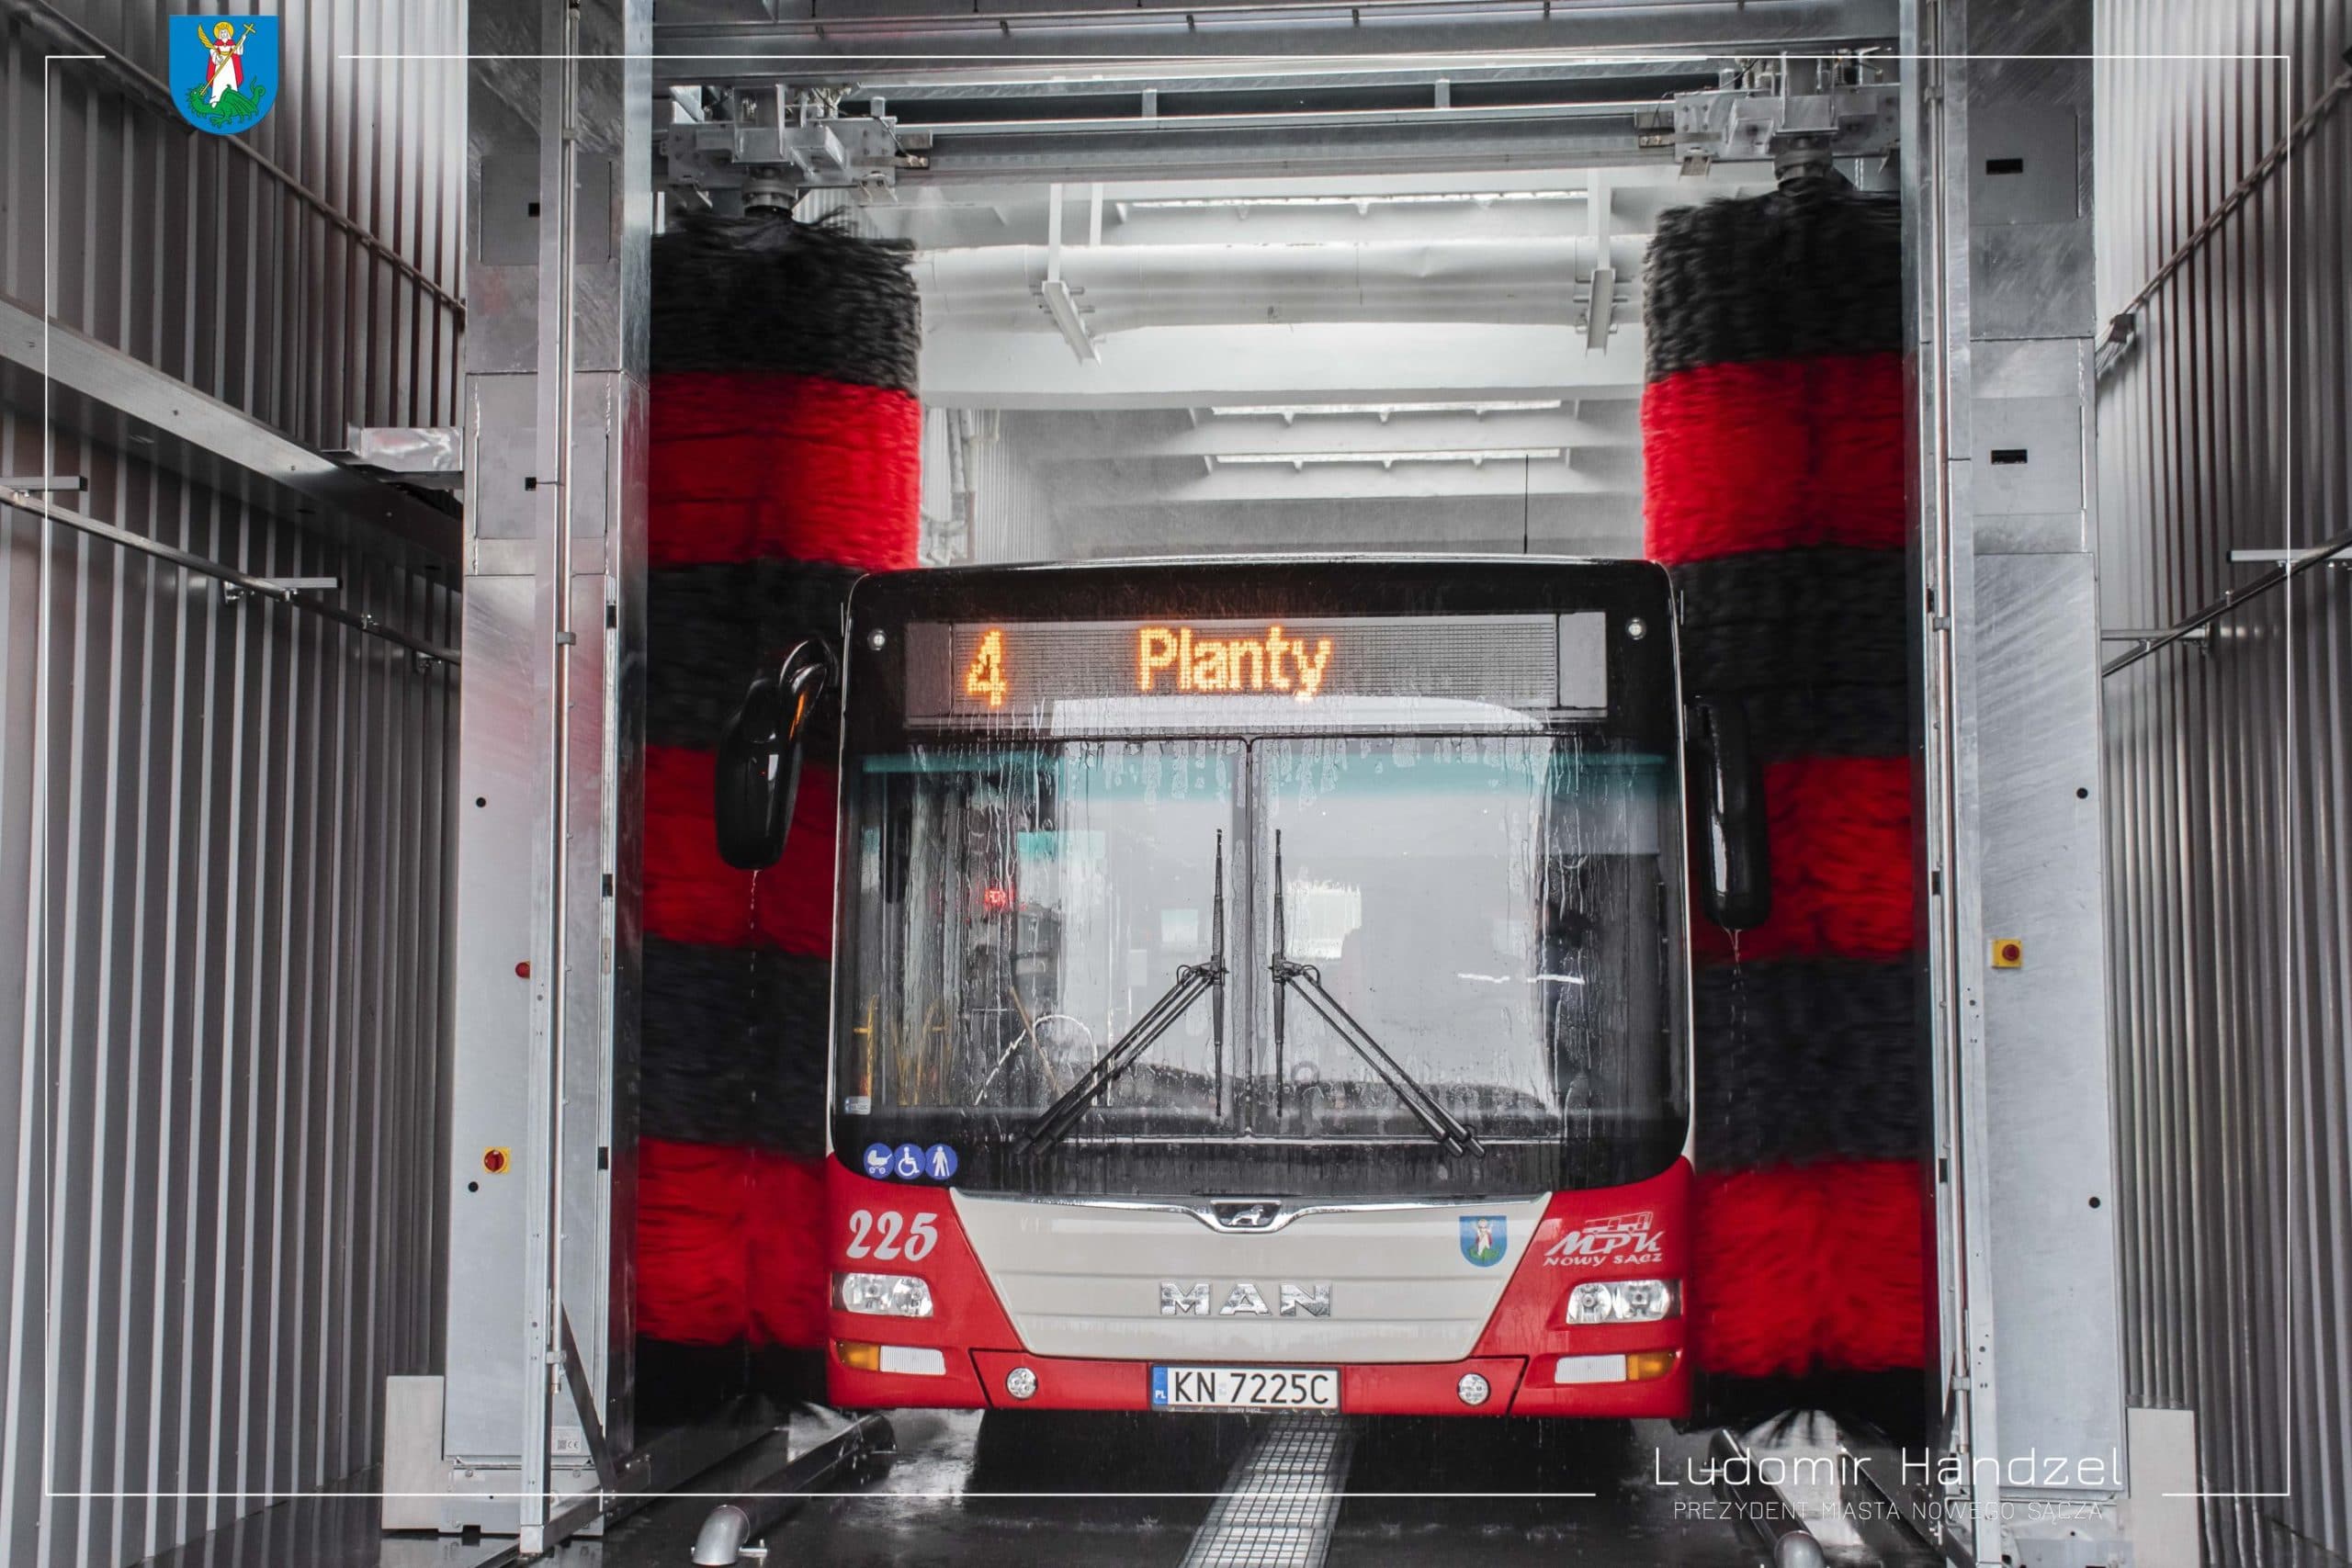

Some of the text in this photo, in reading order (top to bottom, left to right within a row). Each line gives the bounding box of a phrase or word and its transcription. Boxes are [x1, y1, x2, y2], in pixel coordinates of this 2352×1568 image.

[966, 625, 1331, 706] 4 Planty
[846, 1209, 939, 1262] 225
[1544, 1230, 1666, 1257] MPK
[1544, 1257, 1606, 1267] NOWY
[1159, 1282, 1331, 1316] MAN
[1155, 1371, 1329, 1404] PL KN 7225C
